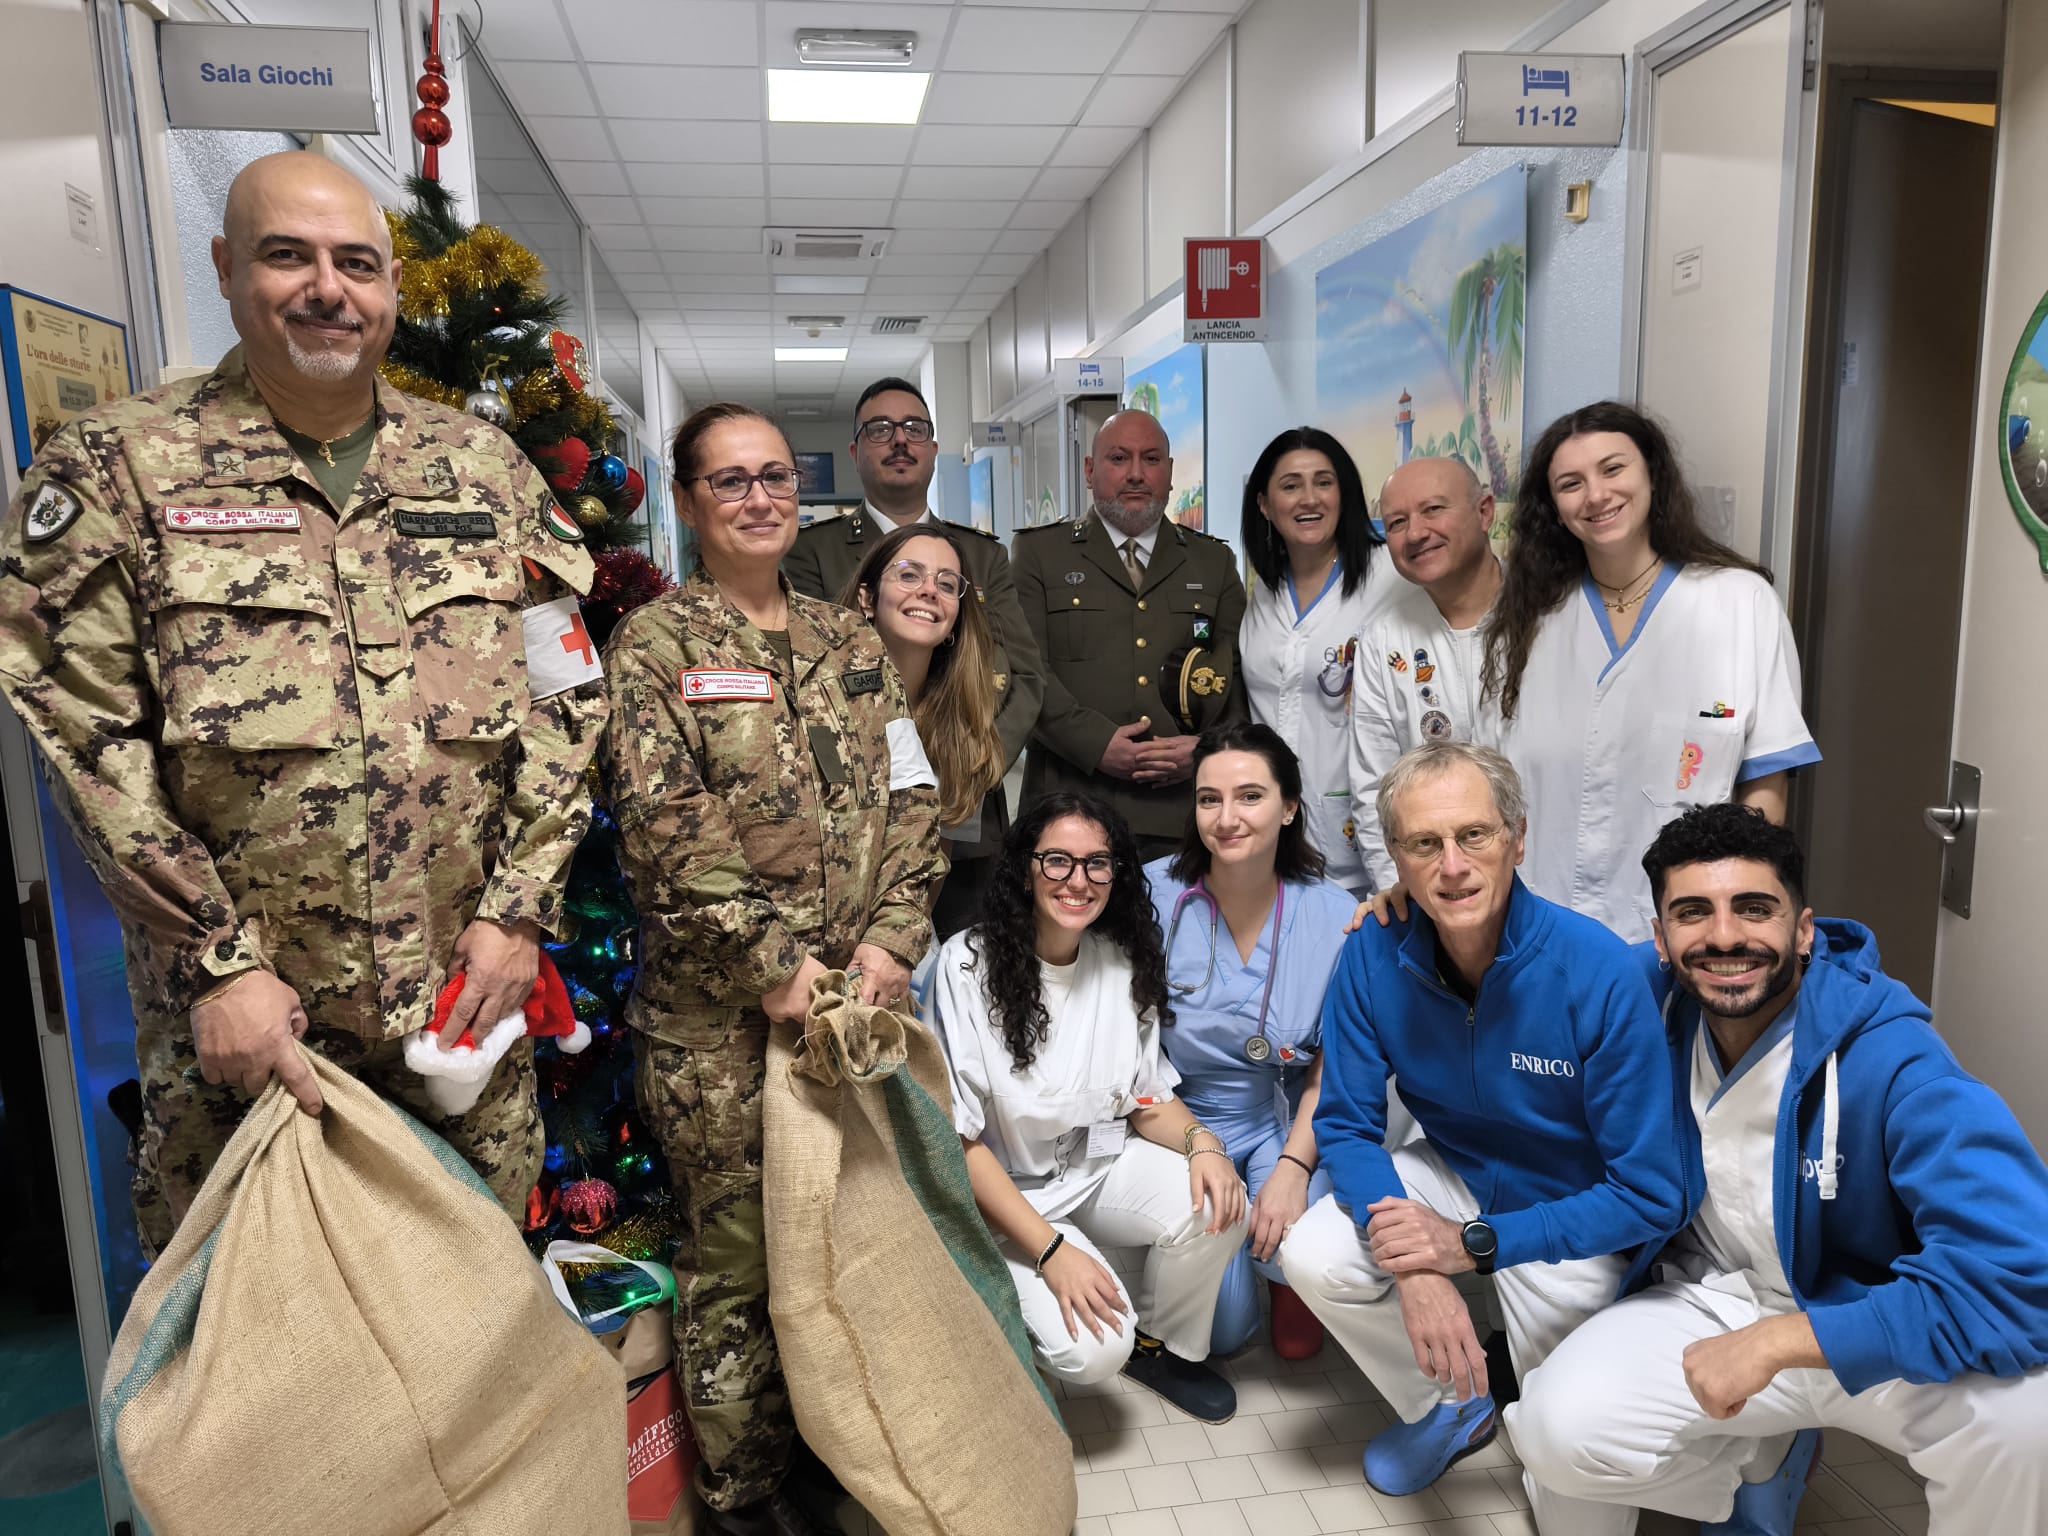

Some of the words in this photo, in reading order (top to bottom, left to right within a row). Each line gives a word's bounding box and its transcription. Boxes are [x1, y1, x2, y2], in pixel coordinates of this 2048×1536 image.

[200, 62, 251, 83] Sala
[258, 64, 333, 87] Giochi
[1515, 105, 1577, 127] 11-12
[1193, 330, 1256, 340] ANTINCENDIO
[1207, 321, 1241, 330] LANCIA
[26, 343, 49, 361] L'ora
[49, 349, 69, 367] delle
[69, 356, 92, 373] storie
[1078, 378, 1104, 388] 14-15
[191, 511, 220, 519] CROCE
[1510, 1051, 1575, 1078] ENRICO
[627, 1432, 687, 1480] uotidiano
[629, 1424, 685, 1468] emplicemente
